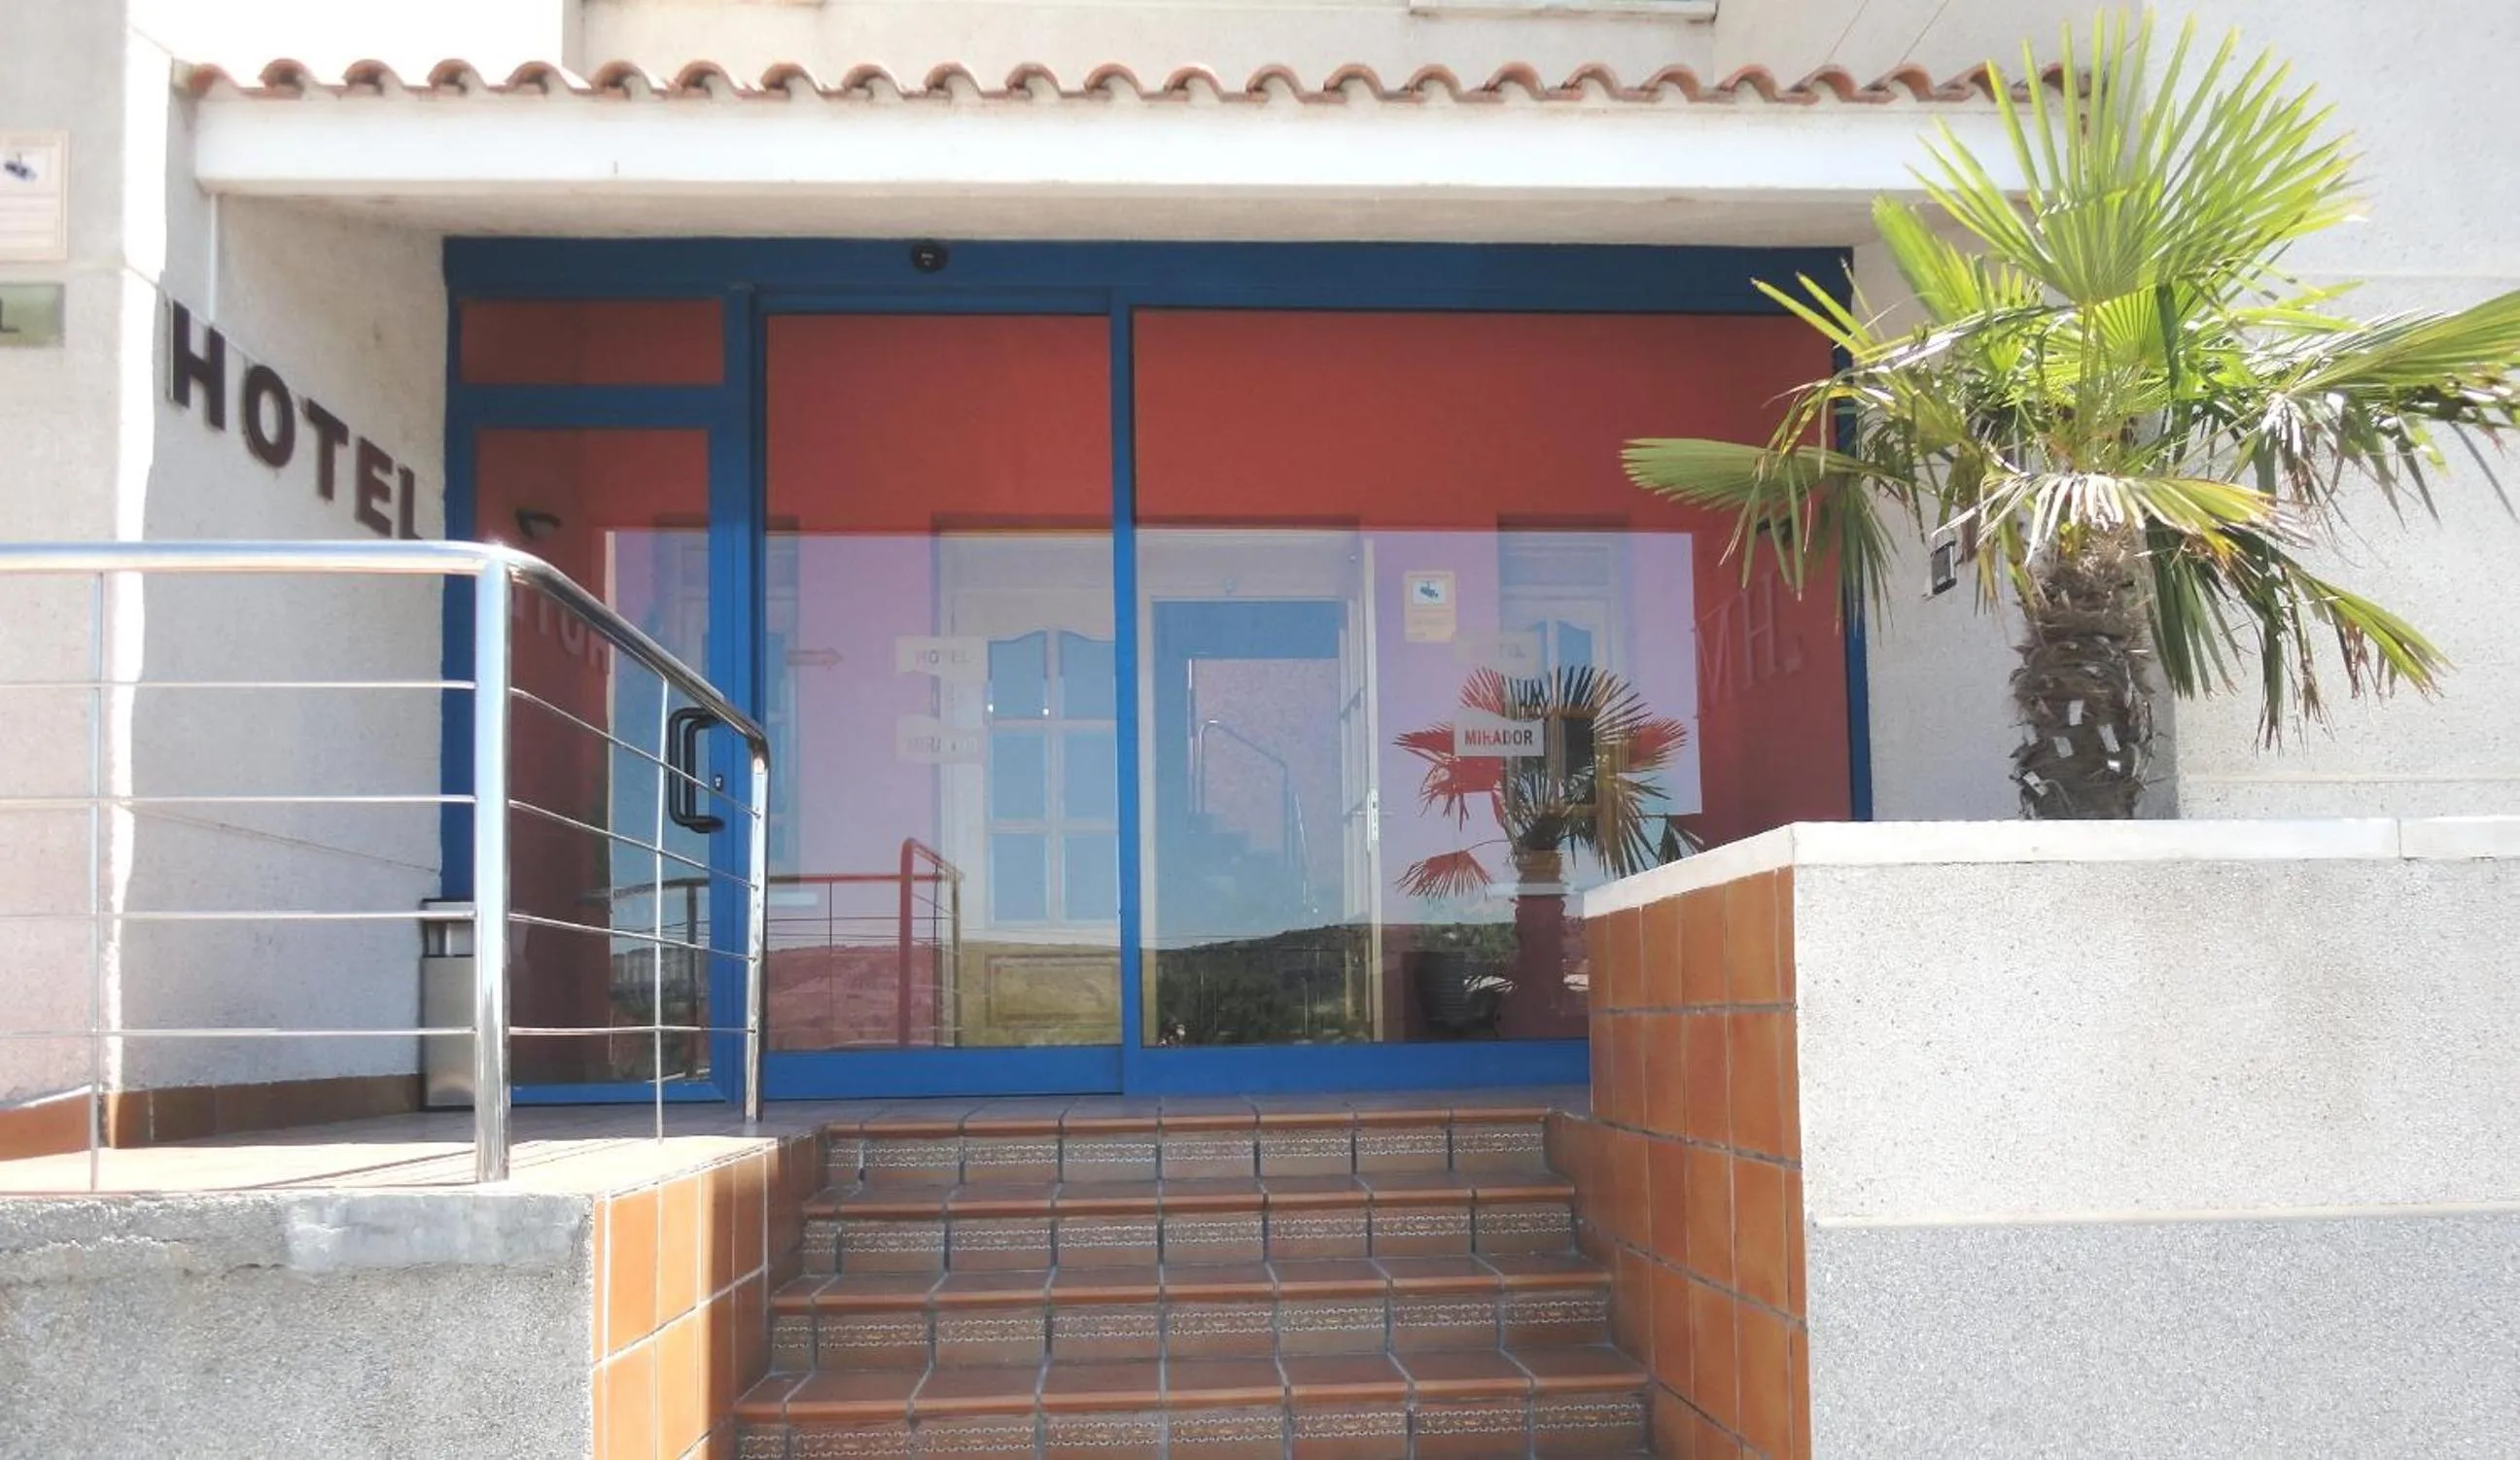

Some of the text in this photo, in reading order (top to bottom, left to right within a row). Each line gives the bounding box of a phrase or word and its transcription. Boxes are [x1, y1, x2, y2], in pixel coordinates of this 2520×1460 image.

[169, 297, 424, 540] HOTEL
[913, 649, 972, 666] HOEL
[1464, 729, 1533, 747] MIRADOR
